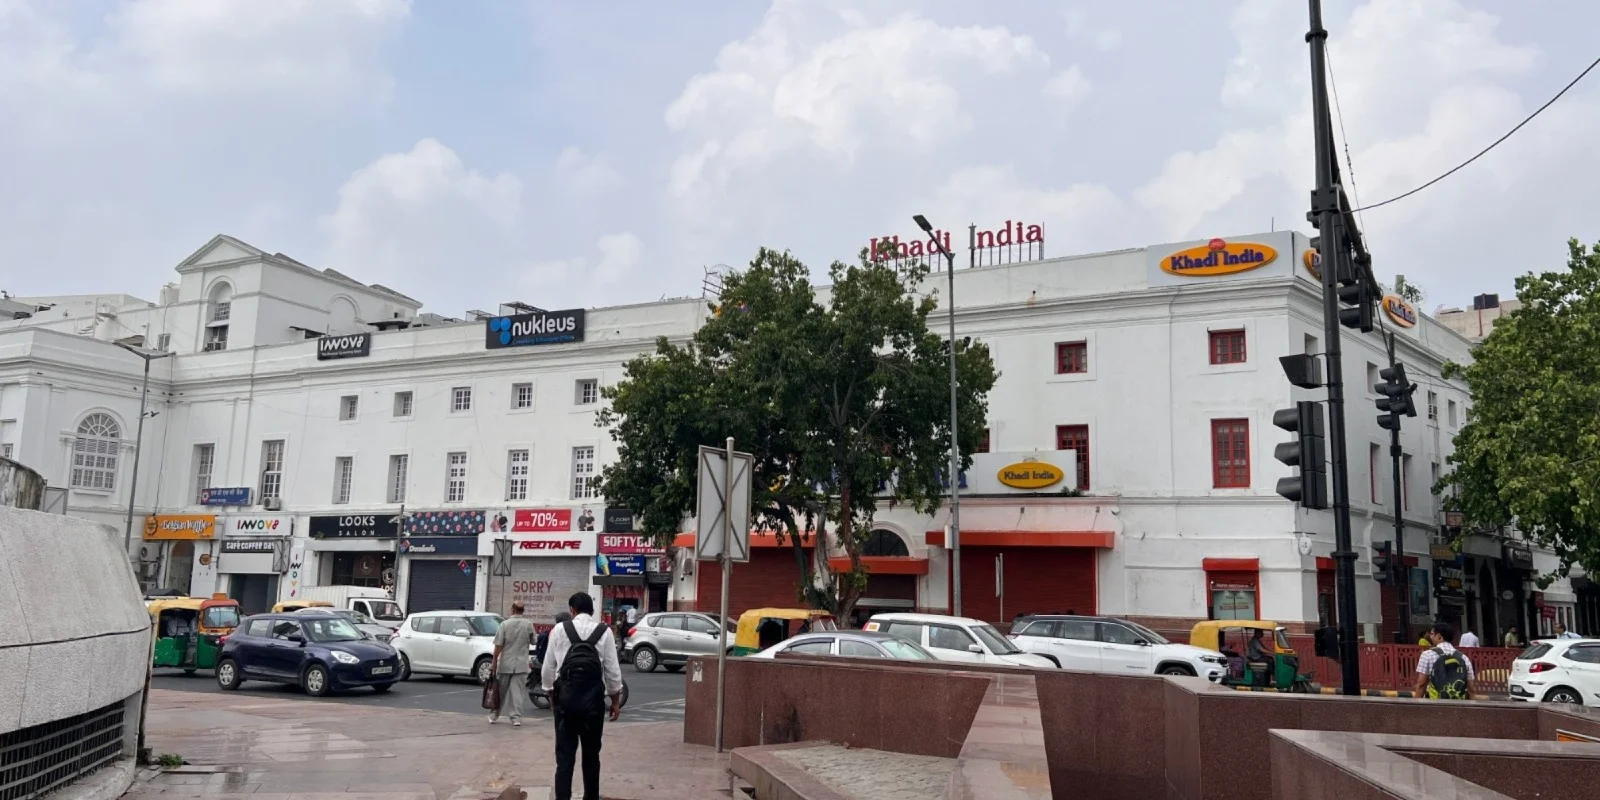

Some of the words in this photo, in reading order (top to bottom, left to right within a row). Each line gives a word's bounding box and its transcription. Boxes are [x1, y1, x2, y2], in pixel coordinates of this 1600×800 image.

[870, 229, 951, 262] Khadi
[968, 220, 1044, 250] India
[1171, 251, 1219, 270] Khadi
[1224, 249, 1265, 265] India
[512, 315, 576, 336] nukleus
[1004, 471, 1030, 480] Khadi
[1032, 470, 1055, 479] India
[339, 516, 376, 526] LOOKS
[530, 512, 558, 527] 70%
[519, 540, 582, 550] REDTAPE
[513, 580, 553, 593] SORRY
